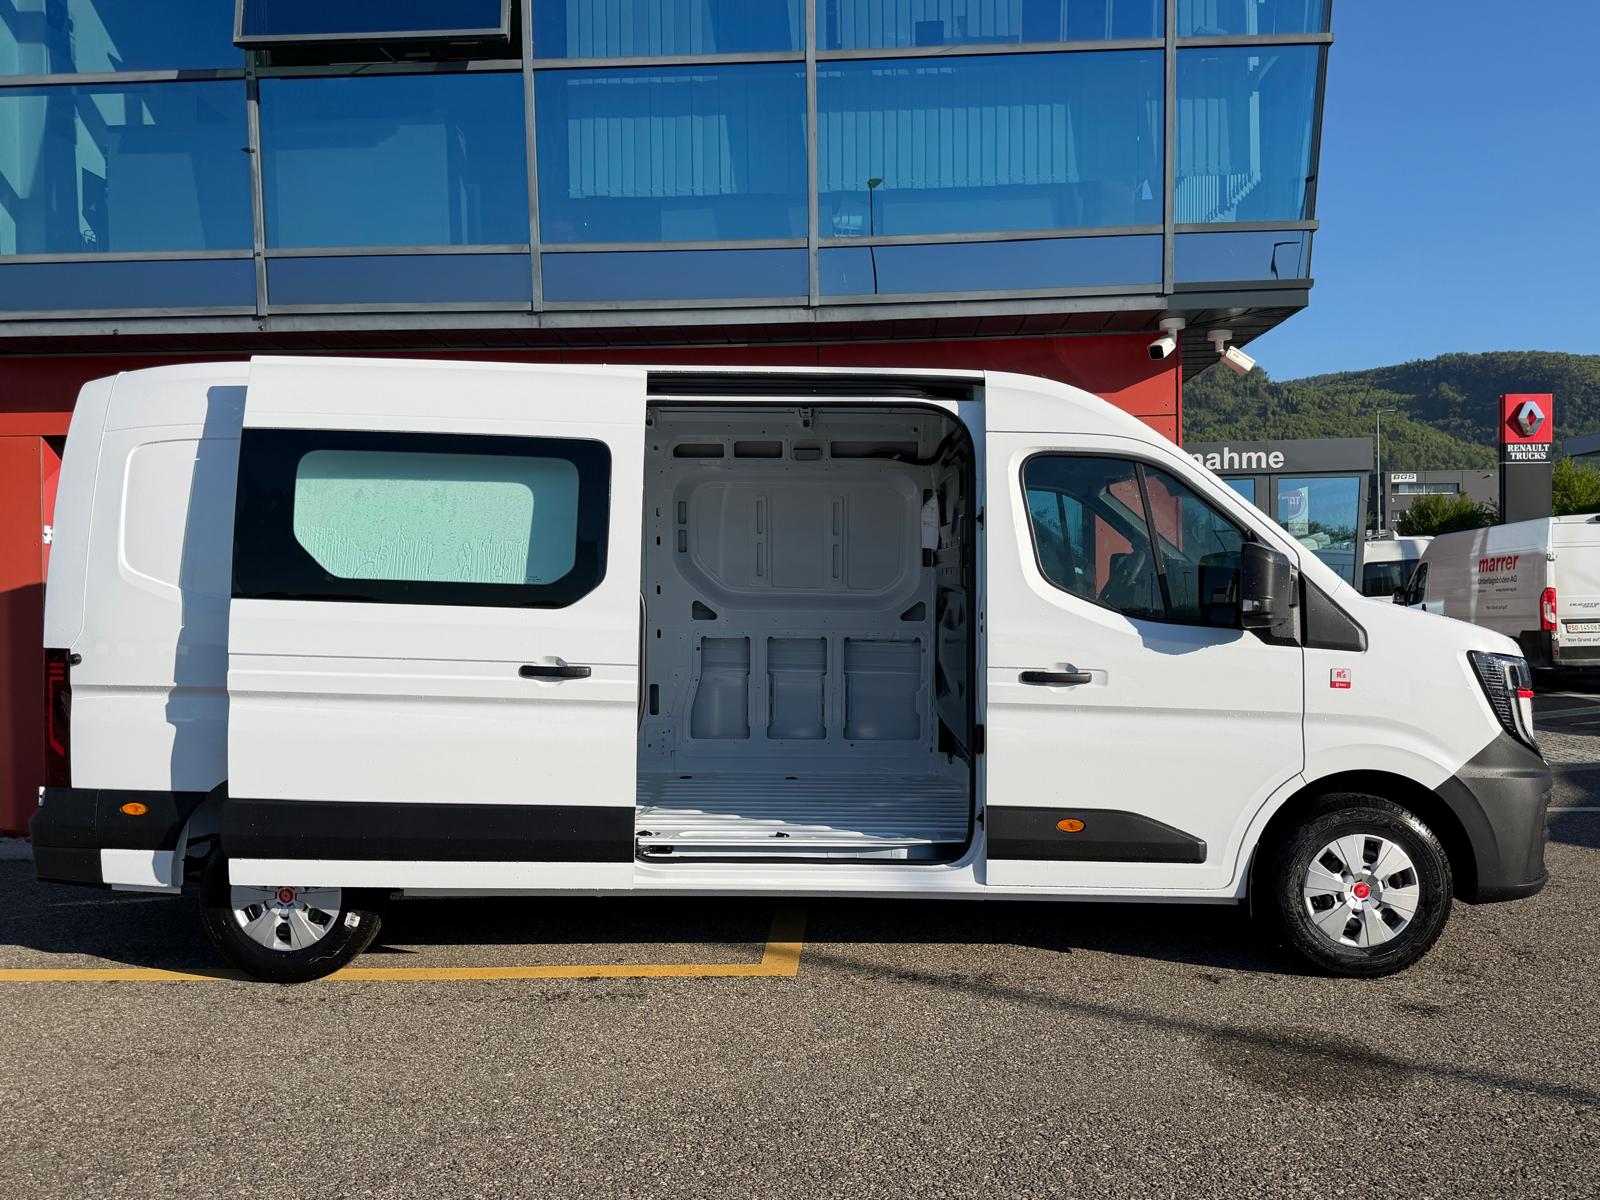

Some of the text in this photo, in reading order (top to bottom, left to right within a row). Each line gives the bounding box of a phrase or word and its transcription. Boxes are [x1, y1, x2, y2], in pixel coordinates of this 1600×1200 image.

[1507, 444, 1550, 452] RENAULT
[1510, 452, 1546, 460] TRUCKS
[1478, 555, 1520, 573] marrer
